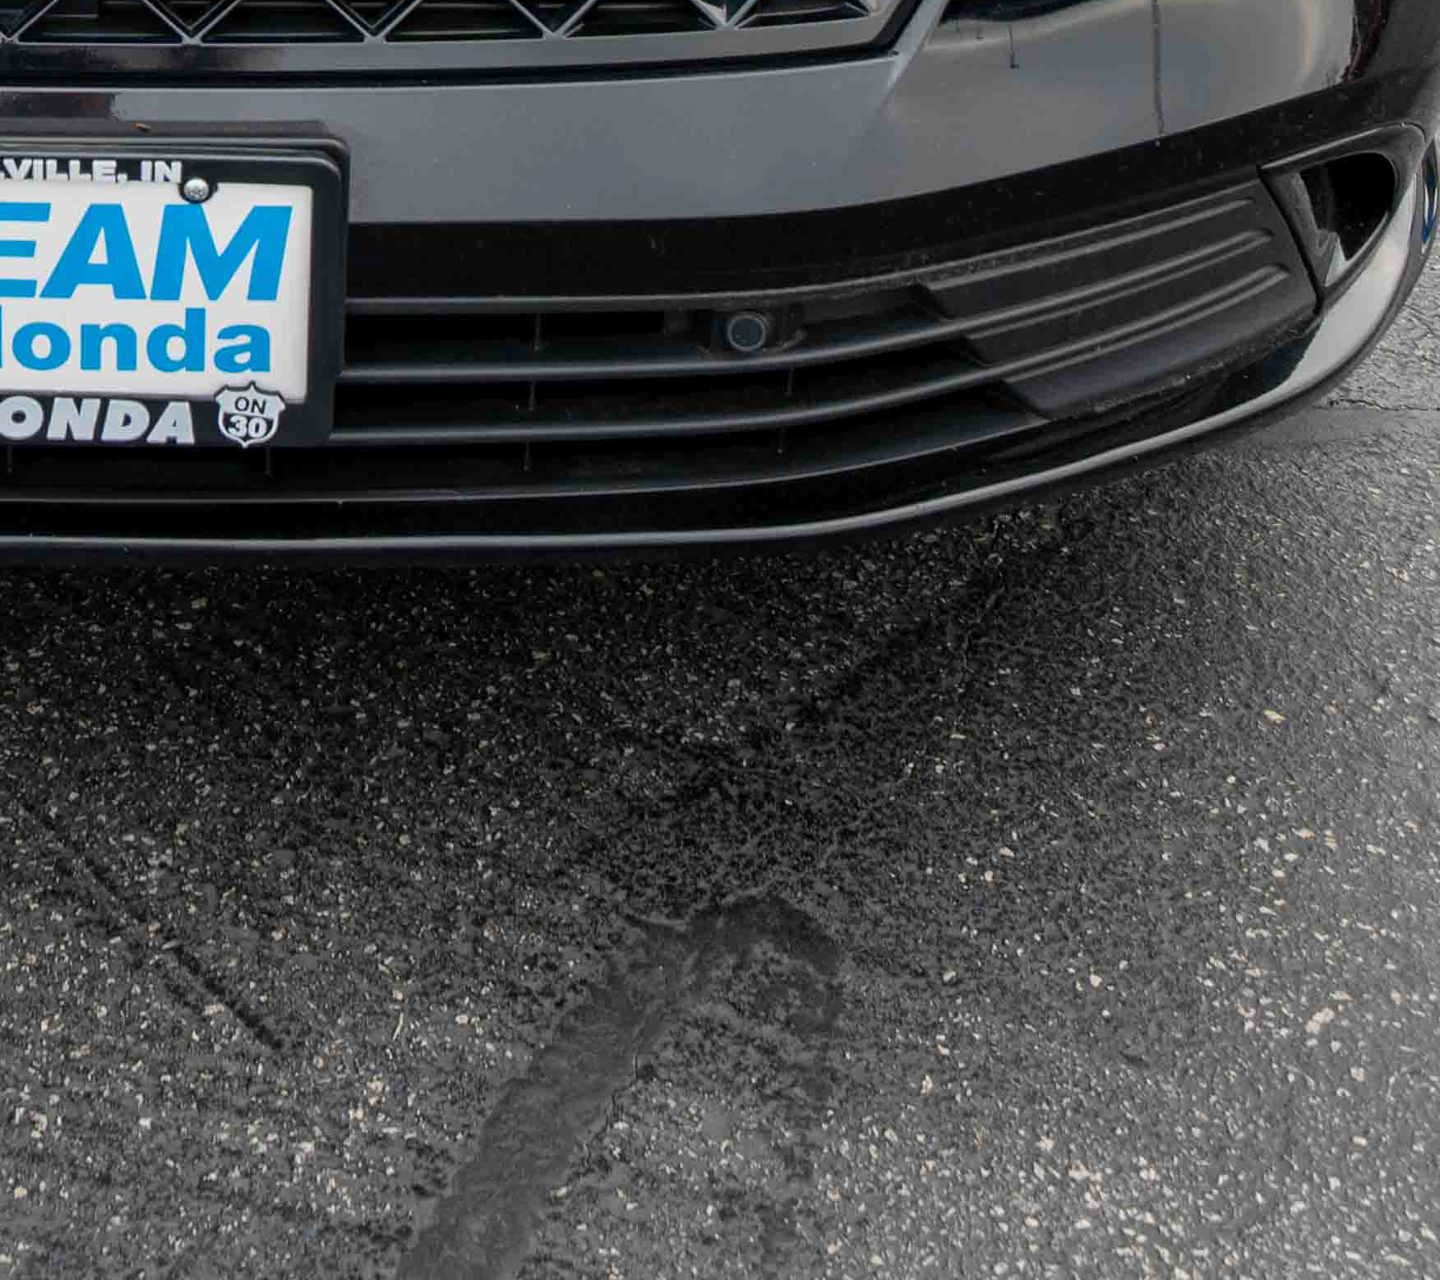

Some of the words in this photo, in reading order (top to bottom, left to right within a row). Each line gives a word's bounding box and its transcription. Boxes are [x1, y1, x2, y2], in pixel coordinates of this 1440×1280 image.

[140, 160, 182, 183] IN
[234, 396, 267, 414] ON
[227, 415, 268, 438] 30
